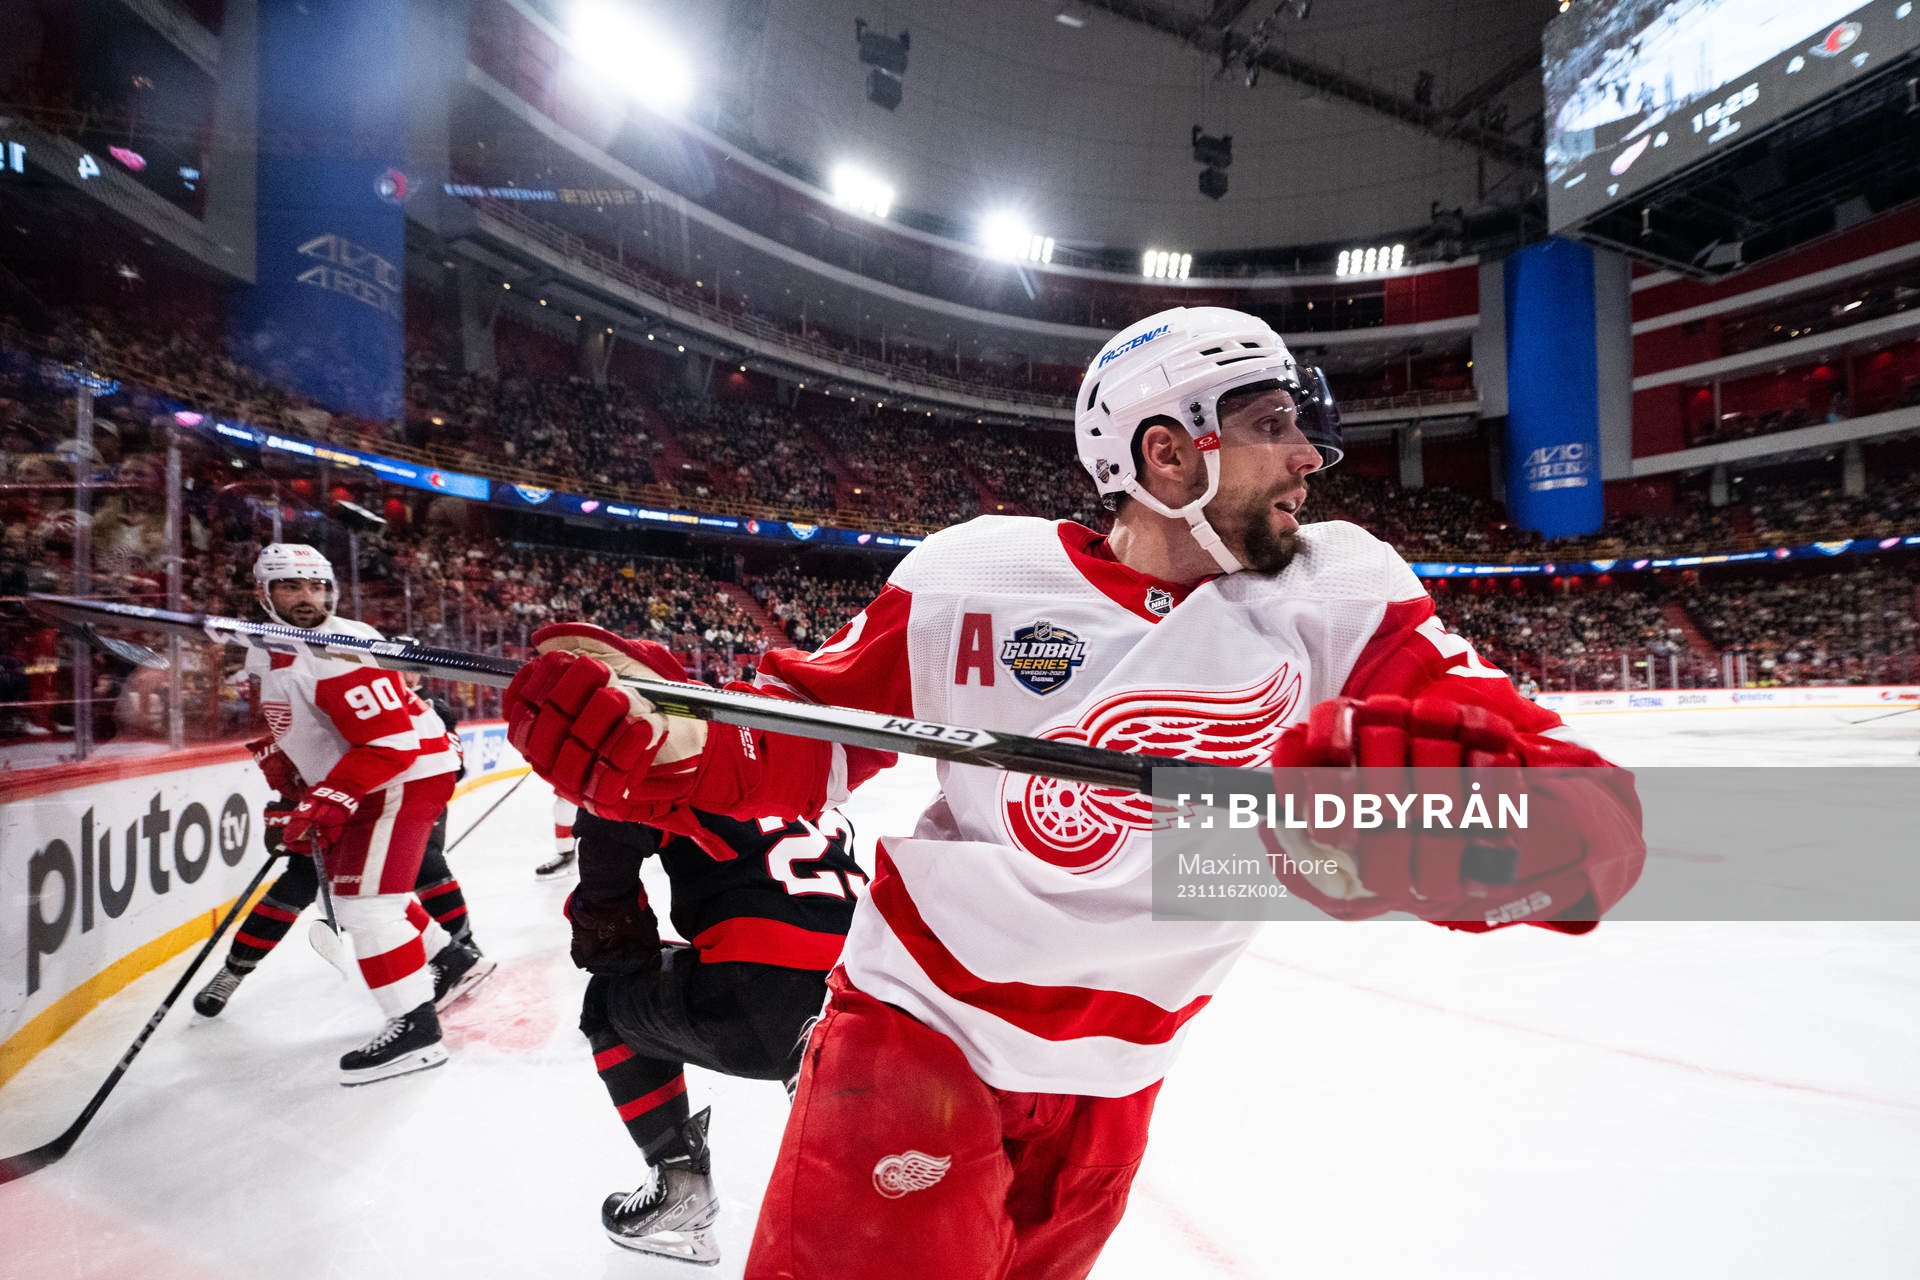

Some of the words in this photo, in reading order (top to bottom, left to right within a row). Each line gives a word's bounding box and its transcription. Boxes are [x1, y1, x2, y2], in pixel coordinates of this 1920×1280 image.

[954, 612, 995, 687] A
[1001, 640, 1087, 661] GLOBAL
[1011, 658, 1070, 671] SERIES
[344, 676, 404, 721] 90
[883, 718, 979, 744] CCM
[221, 811, 247, 853] tv
[27, 790, 213, 998] pluto
